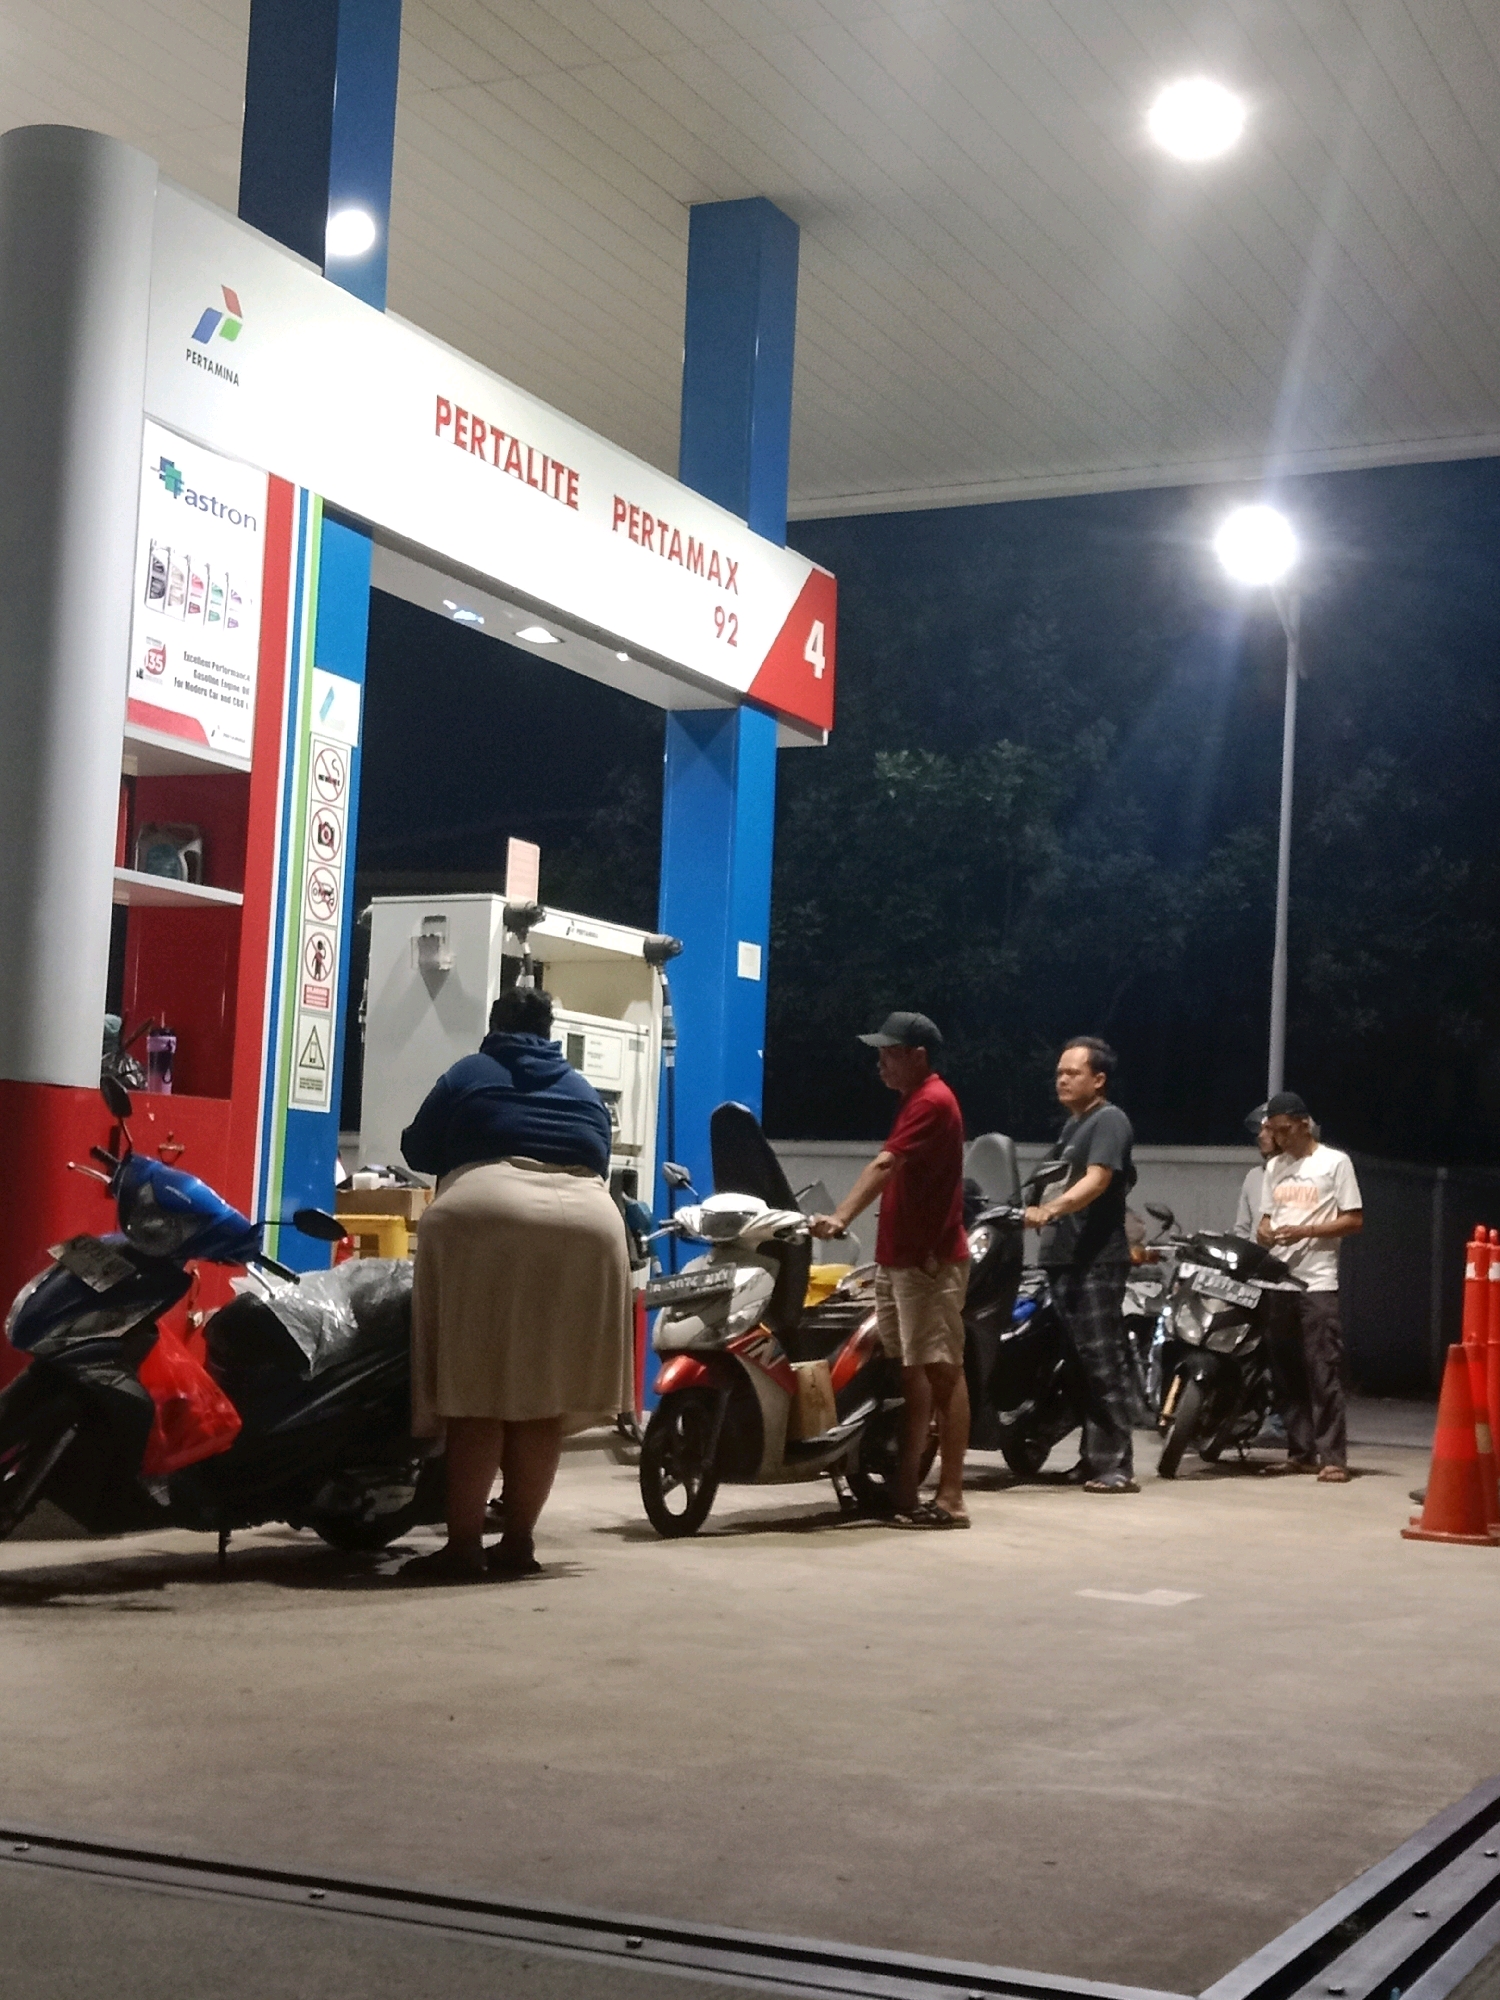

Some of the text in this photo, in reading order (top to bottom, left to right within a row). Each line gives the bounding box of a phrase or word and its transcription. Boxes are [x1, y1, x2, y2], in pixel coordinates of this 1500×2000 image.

[186, 348, 240, 387] PERTAMINA
[435, 394, 580, 511] PERTALITE
[612, 494, 739, 596] PERTAMAX
[714, 605, 739, 648] 92
[803, 619, 827, 679] 4
